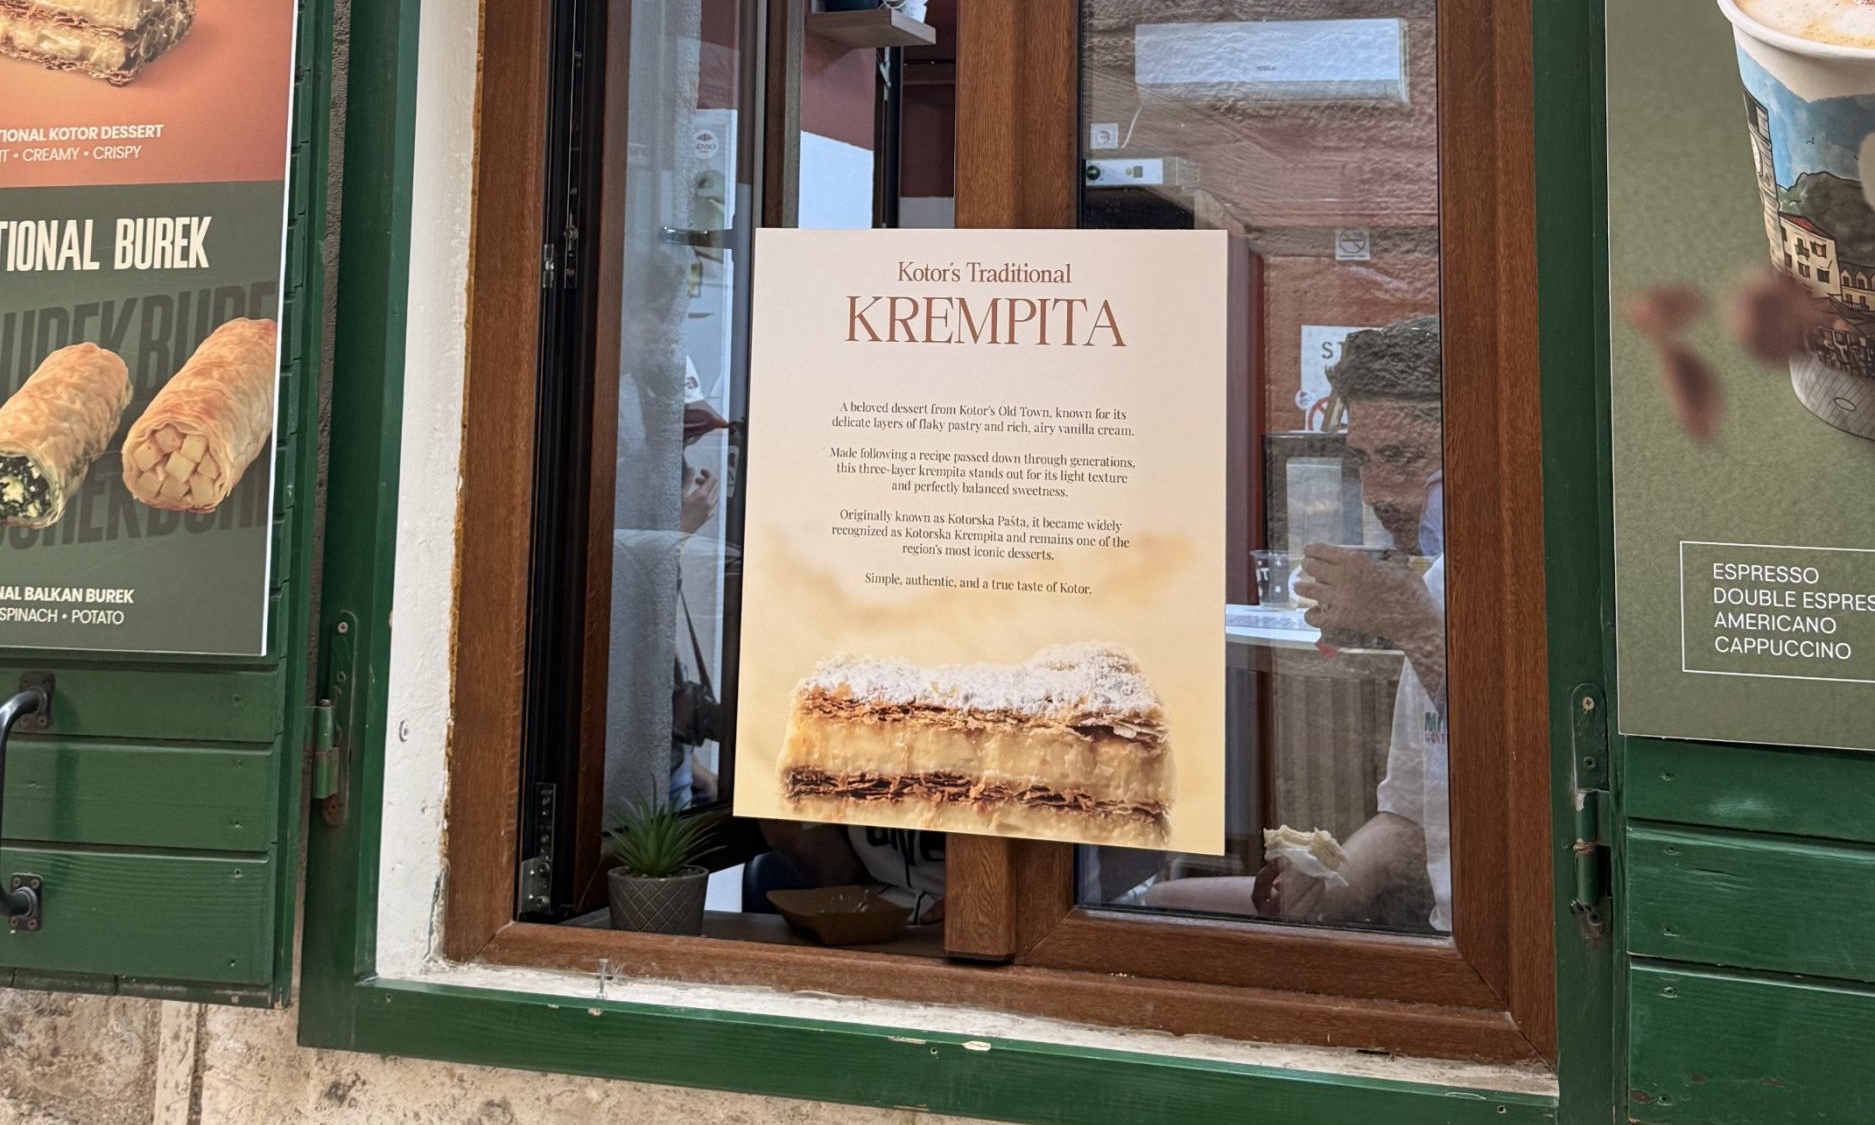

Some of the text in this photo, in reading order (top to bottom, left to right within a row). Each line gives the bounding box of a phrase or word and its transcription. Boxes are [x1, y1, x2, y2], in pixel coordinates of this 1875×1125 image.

[0, 124, 165, 142] IONAL KOTOR DESSERT
[23, 147, 80, 162] CREAMY
[93, 145, 142, 160] CRISPY
[114, 216, 212, 270] BUREK
[897, 261, 1072, 283] Kotor's Traditional
[845, 295, 1127, 347] KREMPITA
[840, 401, 1126, 420] A beloved dessert from Kotor's Old Town, known for its
[832, 416, 1134, 436] delicate layers of flaky pastry and rich, airy vanilla cream.
[831, 447, 1135, 468] Made following a recipe passed down through generations,
[837, 463, 1127, 484] this three-layer krempita stands out for its light texture
[892, 481, 1068, 497] and perfectly balanced sweetness.
[840, 509, 892, 523] Originally
[896, 511, 930, 523] known
[948, 513, 994, 525] Kotorska
[1033, 517, 1039, 527] it
[1043, 517, 1083, 530] became
[1087, 519, 1122, 533] widely
[832, 526, 1130, 548] recognized as Kotorska Krempita and remains one of the
[902, 544, 1054, 561] region's most iconic desserts.
[865, 573, 1091, 594] Simple, authentic, and a true taste of Kotor.
[1713, 563, 1819, 584] ESPRESSO
[24, 587, 82, 601] BALKAN
[85, 588, 134, 603] BUREK
[1714, 587, 1875, 612] DOUBLE ESPRES
[0, 607, 124, 625] SPINACH POTATO
[1714, 612, 1837, 634] AMERICANO
[1715, 636, 1851, 659] CAPPUCCINO
